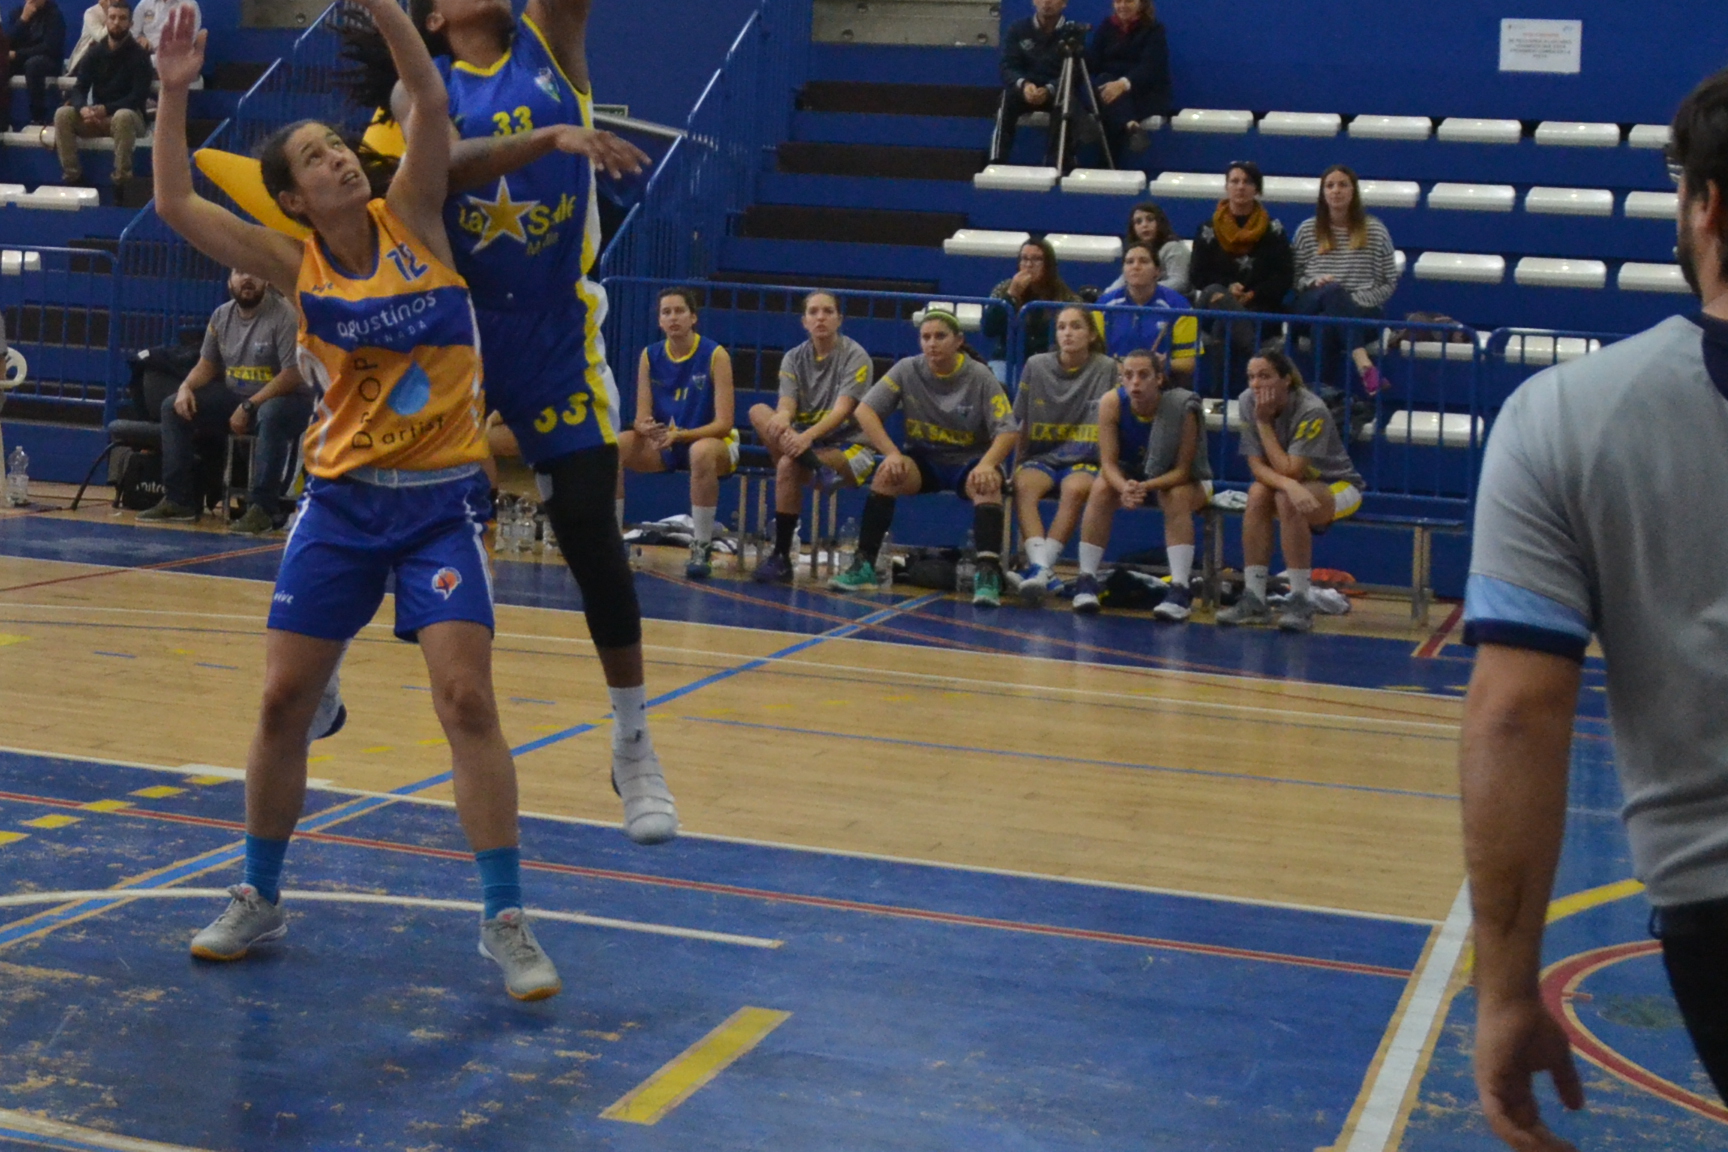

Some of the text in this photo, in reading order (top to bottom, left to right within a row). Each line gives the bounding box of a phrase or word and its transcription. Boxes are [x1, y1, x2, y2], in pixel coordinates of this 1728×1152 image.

[492, 105, 534, 137] 33
[386, 243, 428, 282] 12
[337, 290, 437, 339] agustinos
